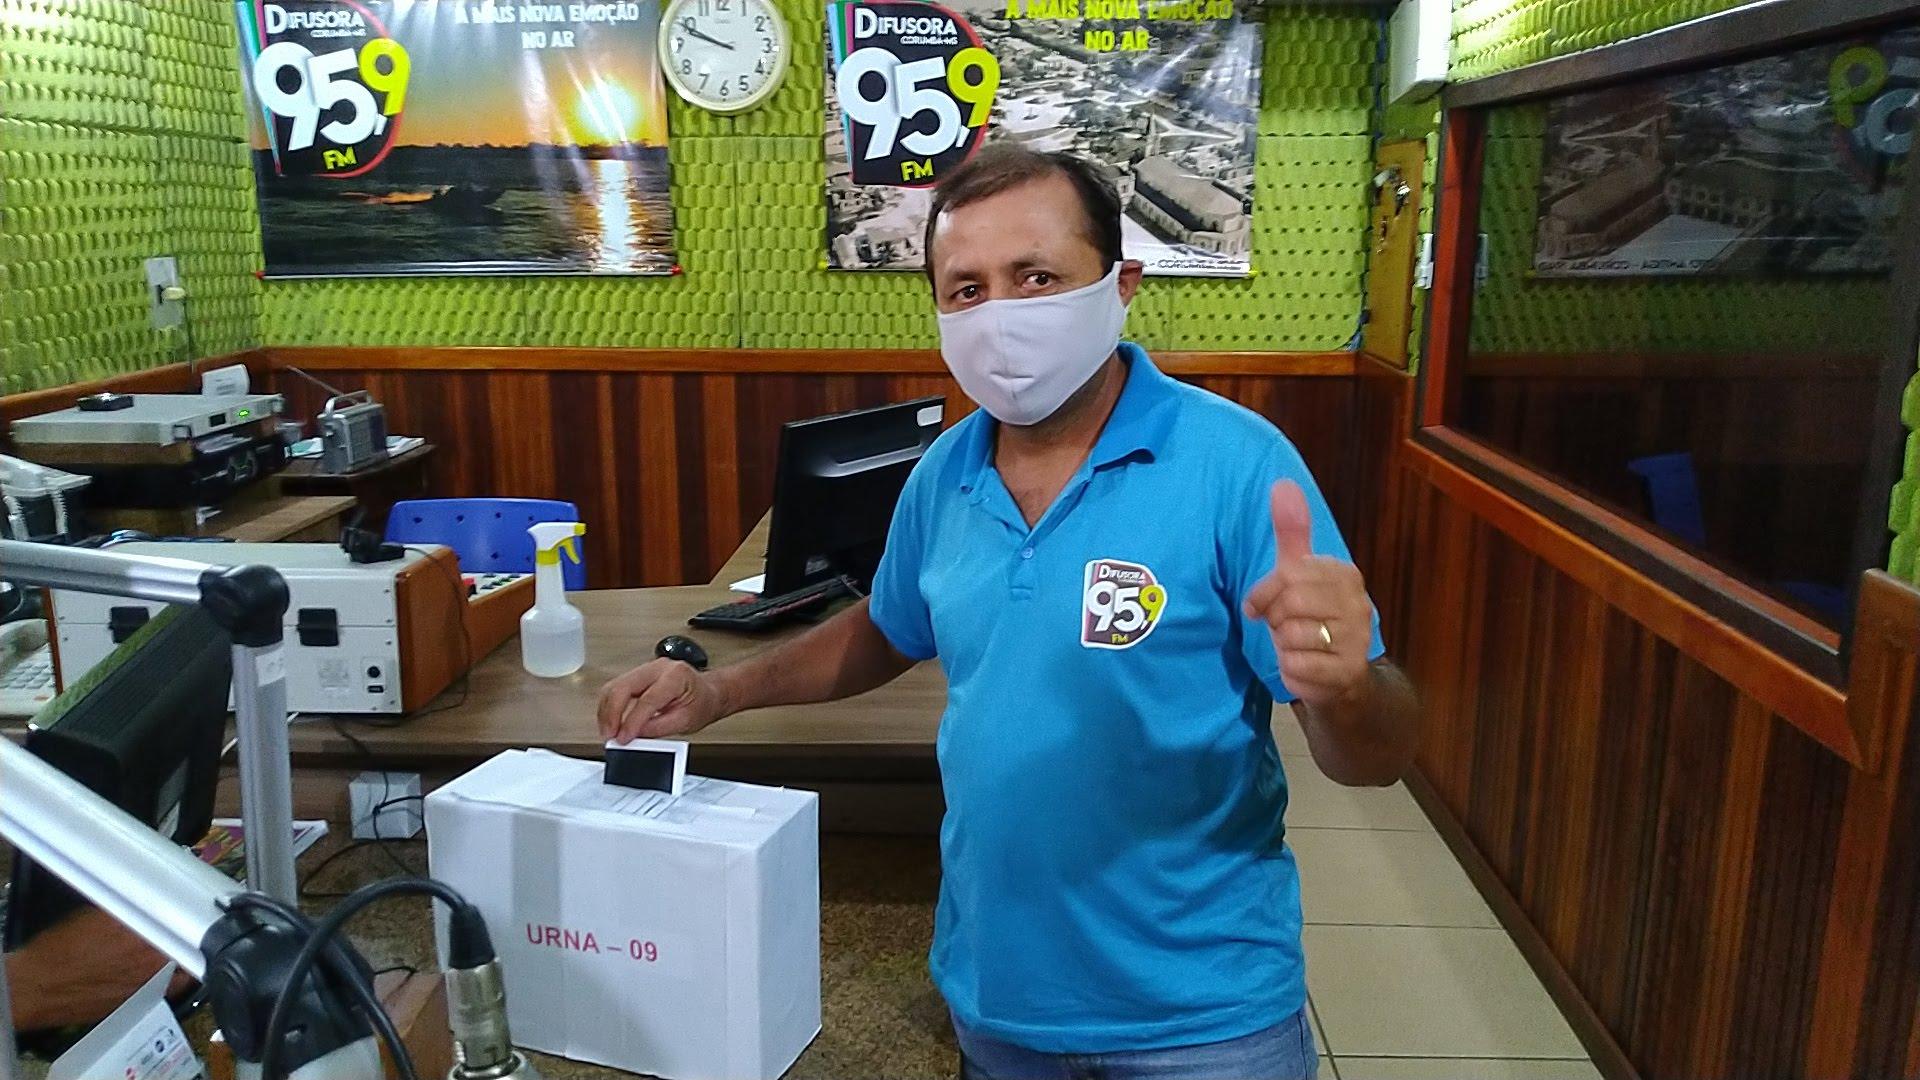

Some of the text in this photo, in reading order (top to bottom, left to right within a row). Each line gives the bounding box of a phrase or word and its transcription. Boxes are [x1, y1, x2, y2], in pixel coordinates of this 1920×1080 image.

[263, 4, 366, 34] DIFUSORA
[455, 1, 640, 26] A MAIS NOVA EMOÇÃO
[1005, 0, 1021, 19] A
[1026, 0, 1081, 19] MAIS
[1084, 0, 1140, 20] NOVA
[754, 15, 766, 32] 2
[854, 8, 958, 39] DIFUSORA
[521, 31, 576, 49] NO AR
[762, 37, 773, 54] 3
[1084, 30, 1151, 51] NO AR
[682, 58, 693, 75] 8
[754, 57, 766, 74] 4
[698, 73, 710, 90] 7
[719, 79, 730, 97] 6
[738, 75, 750, 91] 5
[254, 38, 411, 151] 95,9
[836, 47, 1001, 160] 95,9
[322, 146, 357, 171] FM
[901, 159, 935, 183] FM
[1087, 580, 1164, 632] 95,9
[1111, 633, 1130, 644] FM
[527, 922, 600, 954] URNA
[630, 939, 657, 962] 09
